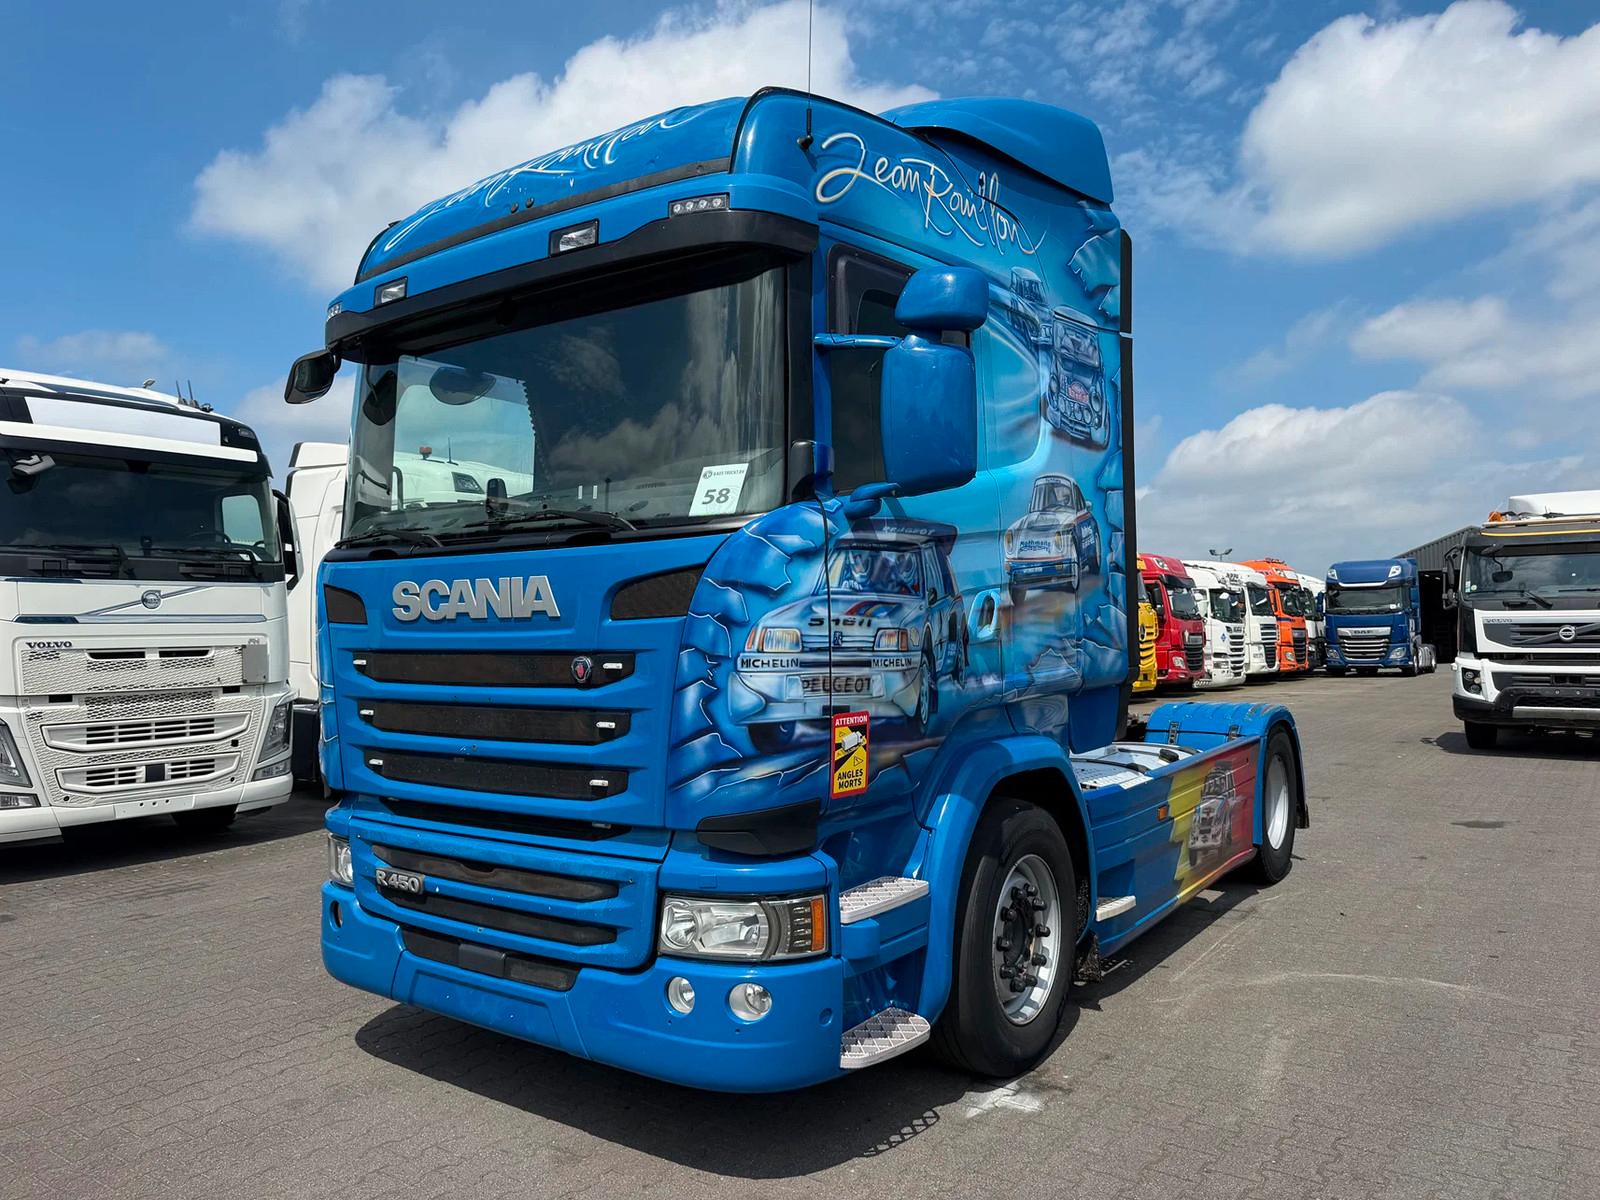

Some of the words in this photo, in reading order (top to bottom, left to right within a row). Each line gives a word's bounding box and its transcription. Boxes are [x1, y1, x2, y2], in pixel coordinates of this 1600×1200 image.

[702, 487, 731, 505] 58
[392, 575, 560, 622] SCANIA
[25, 640, 72, 649] VOLVO
[740, 657, 799, 669] MICHELIN
[871, 657, 912, 668] MICHELIN
[802, 675, 871, 693] PEUGEOT
[835, 714, 868, 726] ATTENTION
[837, 768, 864, 781] ANGLES
[838, 778, 862, 790] MORTS
[388, 873, 420, 893] 450
